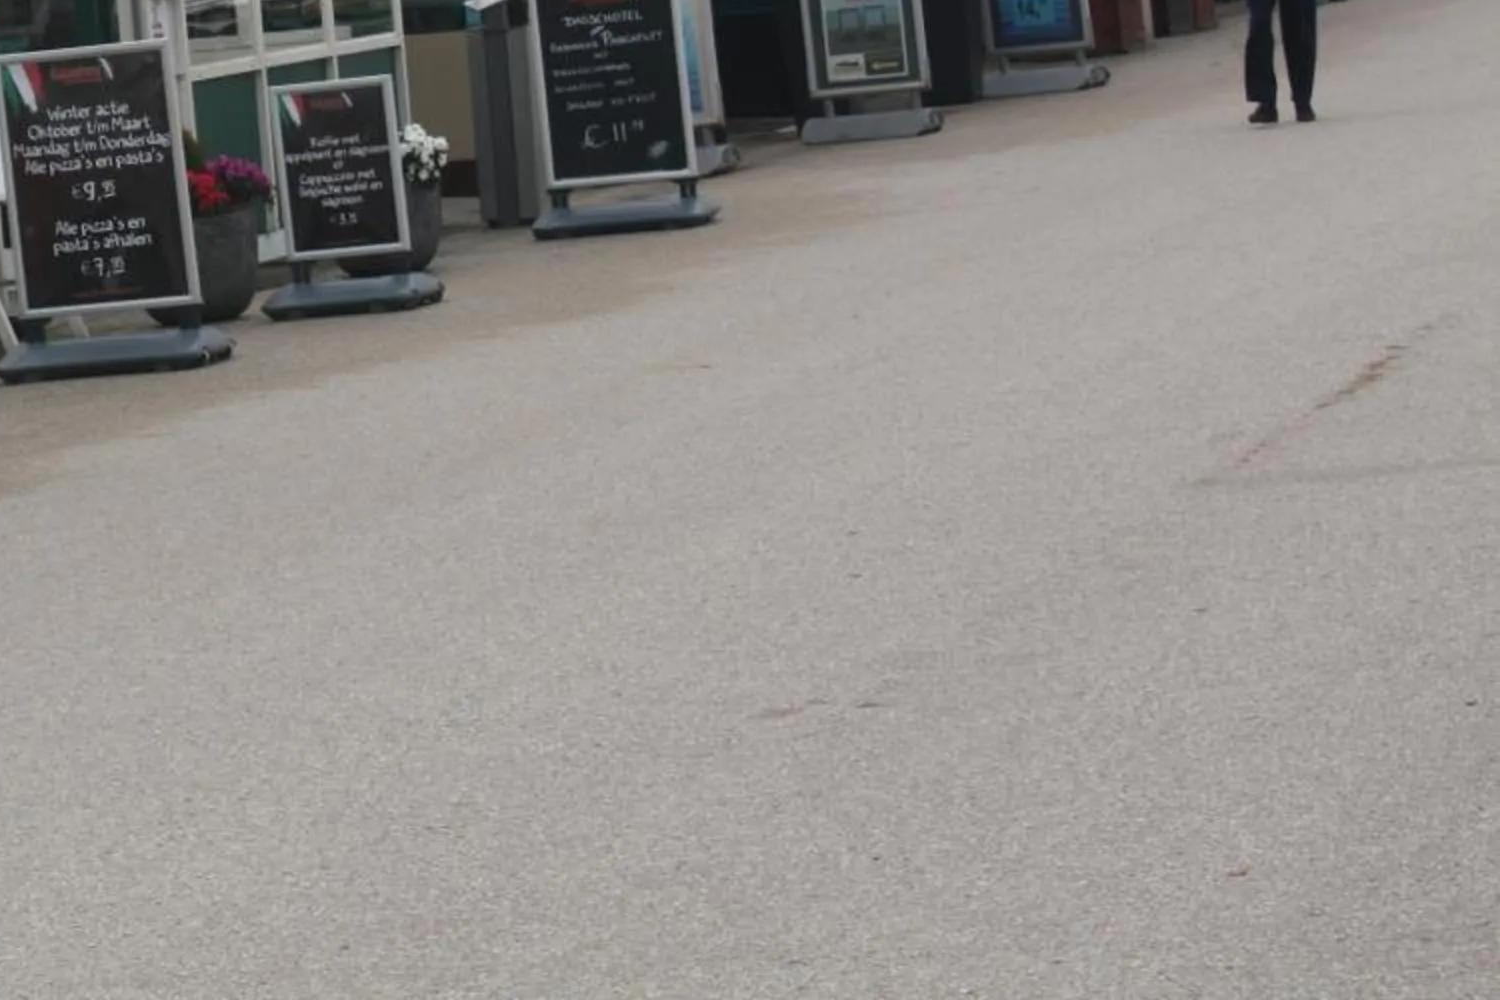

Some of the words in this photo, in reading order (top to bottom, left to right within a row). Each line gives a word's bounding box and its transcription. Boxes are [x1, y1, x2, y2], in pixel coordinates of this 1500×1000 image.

[47, 105, 92, 121] Winter
[95, 100, 130, 117] actie
[28, 123, 81, 141] Oktober
[86, 120, 109, 135] t/m
[111, 115, 151, 131] Maart
[13, 141, 70, 160] Maandag
[74, 137, 97, 153] t/m
[99, 130, 173, 151] Donderdag
[24, 159, 47, 176] Alle
[49, 155, 92, 177] pizza's
[95, 154, 113, 168] en
[115, 148, 164, 169] pasta's
[55, 216, 78, 236] Alle
[81, 216, 125, 236] pizza's
[127, 216, 146, 230] en
[52, 236, 101, 258] pasta's
[103, 232, 153, 250] afhalen
